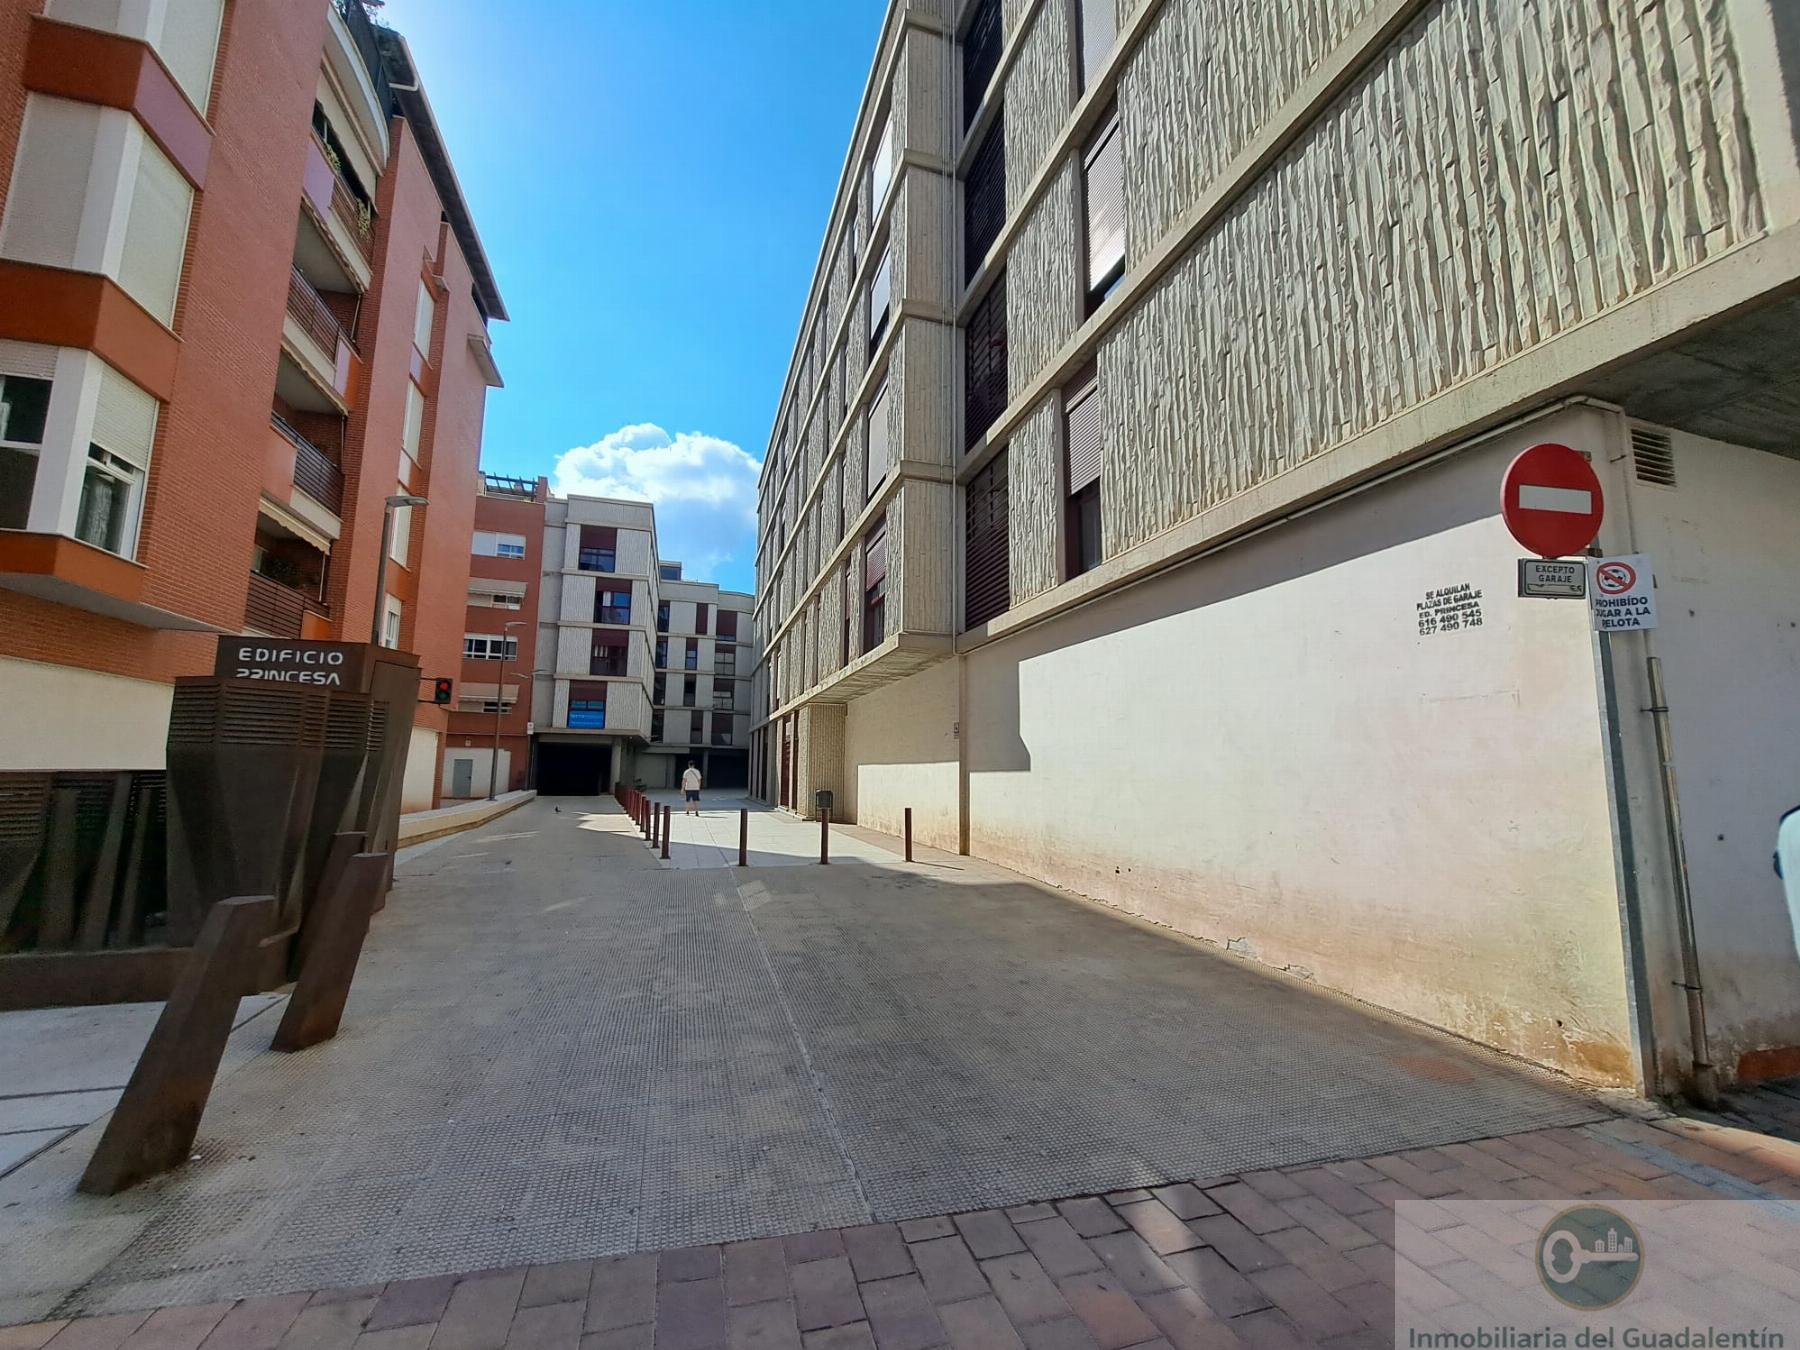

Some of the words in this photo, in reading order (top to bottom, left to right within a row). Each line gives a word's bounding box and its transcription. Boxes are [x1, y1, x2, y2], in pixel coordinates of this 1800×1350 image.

[1535, 565, 1575, 574] EXCEPTO
[1538, 574, 1572, 583] GARAJE
[1425, 591, 1434, 600] SE
[1436, 583, 1470, 598] ALQUILAN
[1416, 599, 1441, 611] PLAZAS
[1443, 595, 1453, 606] DE
[1453, 590, 1483, 603] GARAJE
[1434, 601, 1480, 616] PRINCESA
[1418, 617, 1437, 628] 616
[1440, 613, 1459, 624] 490
[1461, 608, 1482, 619] 545
[1625, 608, 1633, 617] A
[1635, 606, 1651, 616] LA
[1419, 625, 1437, 636] 627
[1440, 621, 1460, 632] 490
[1461, 617, 1483, 629] 748
[238, 647, 344, 665] EDIFICIO
